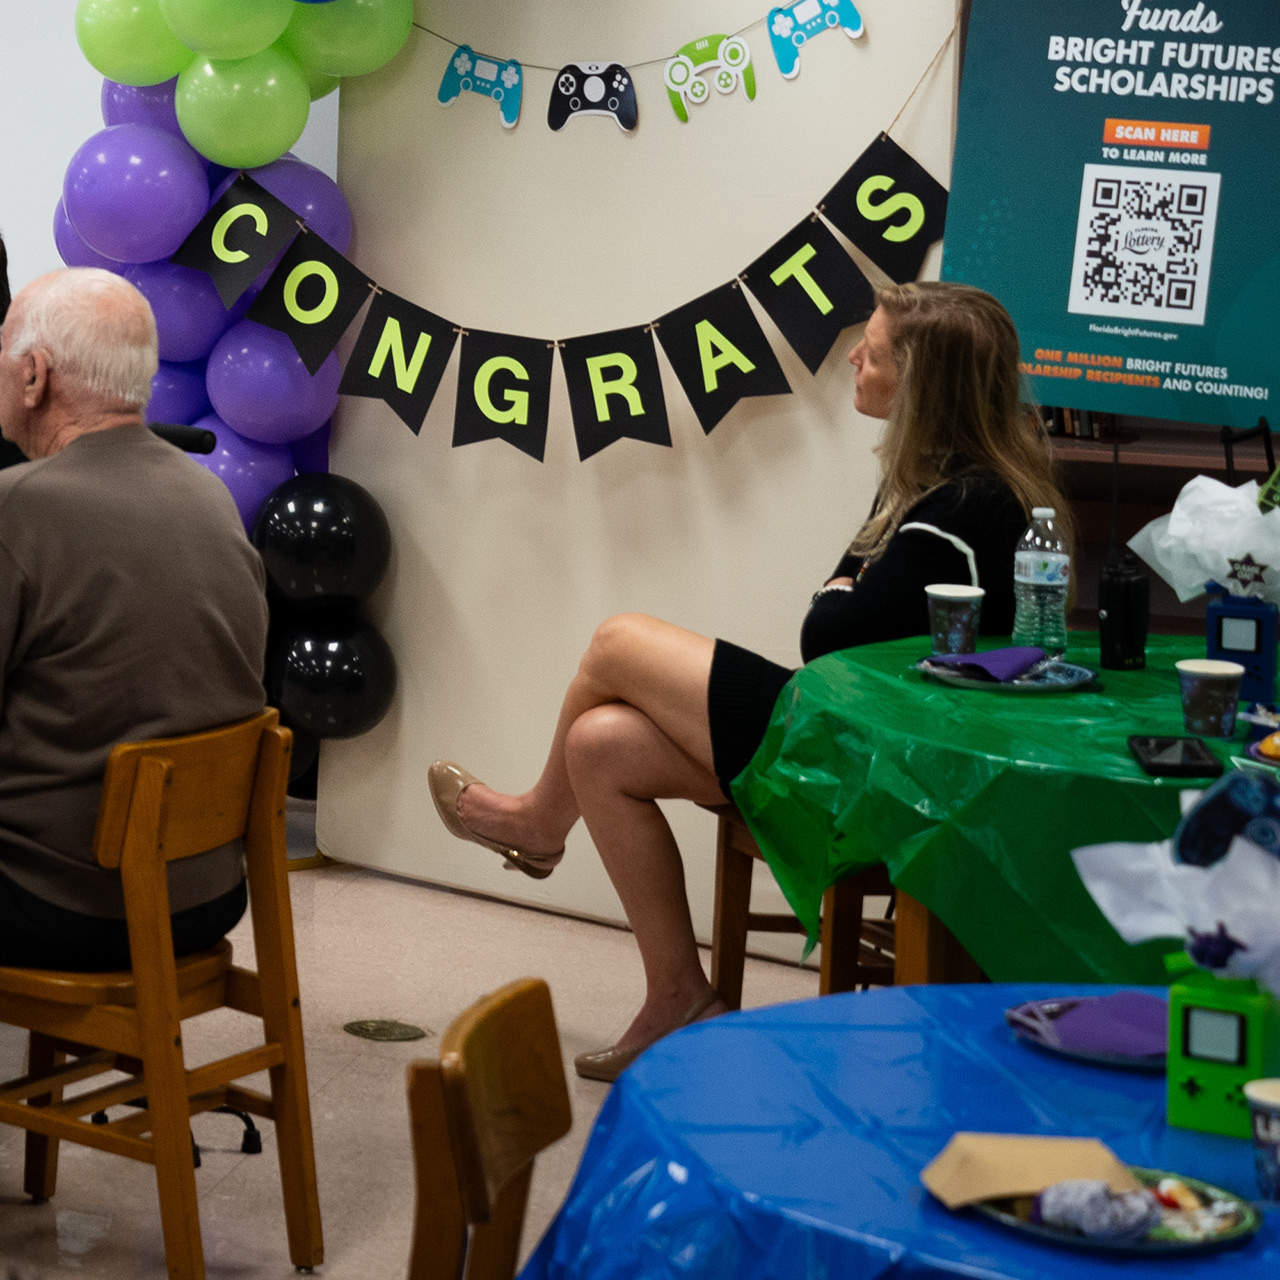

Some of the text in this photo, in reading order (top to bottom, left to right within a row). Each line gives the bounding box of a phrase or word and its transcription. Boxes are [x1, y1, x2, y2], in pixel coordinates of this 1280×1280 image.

[1047, 36, 1280, 73] BRIGHT FUTURES
[1054, 66, 1275, 105] SCHOLARSHIPS
[1115, 126, 1199, 144] SCAN HERE
[1102, 147, 1208, 165] TO LEARN MORE
[1121, 230, 1166, 255] Lottery
[211, 175, 926, 426] CONGRATS
[1017, 362, 1269, 400] OLARSHIP RECIPIENTS AND COUNTING!
[1034, 348, 1228, 380] ONE MILLION BRIGHT FUTURES
